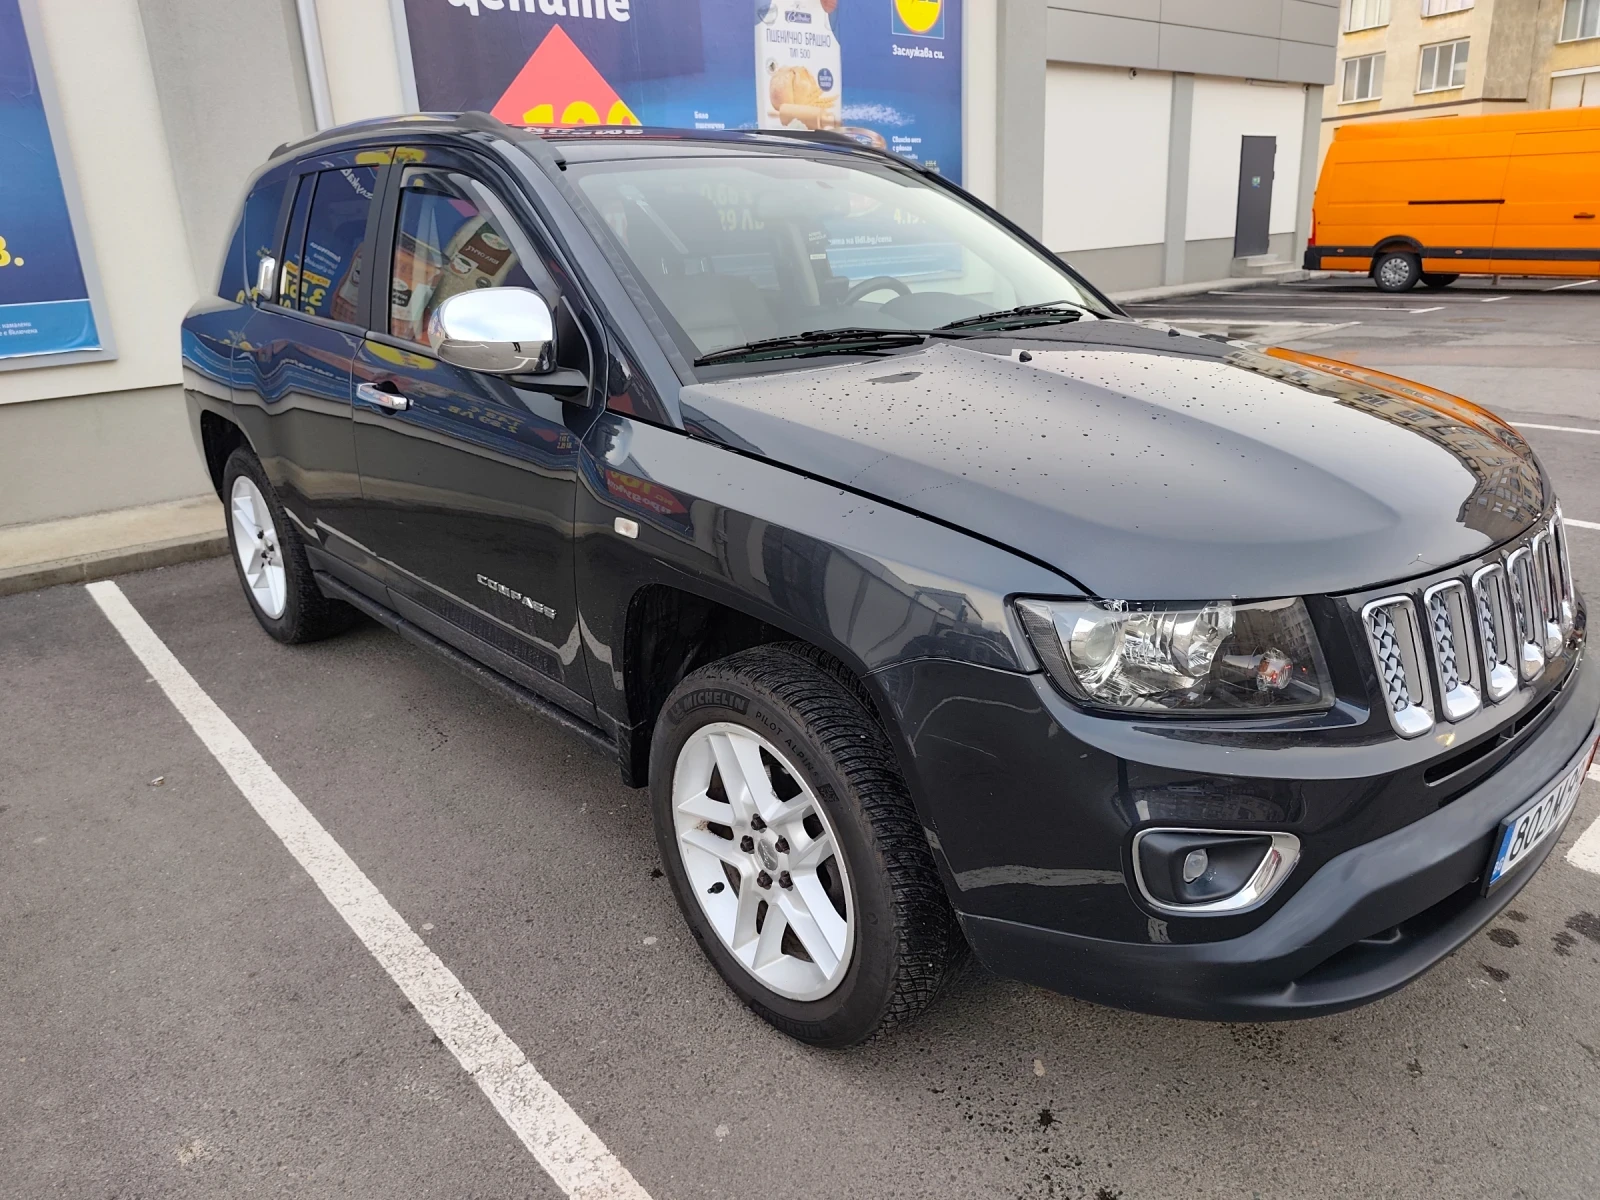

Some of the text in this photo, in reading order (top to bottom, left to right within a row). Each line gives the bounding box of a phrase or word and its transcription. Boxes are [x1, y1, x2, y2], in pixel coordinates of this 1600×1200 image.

[766, 28, 831, 48] ПШЕНИЧНО БРАШНО
[799, 49, 811, 59] 500
[892, 44, 933, 59] Заслужава
[476, 573, 557, 620] COMPASS
[684, 691, 746, 712] MICHELIN
[755, 710, 784, 736] PILOT
